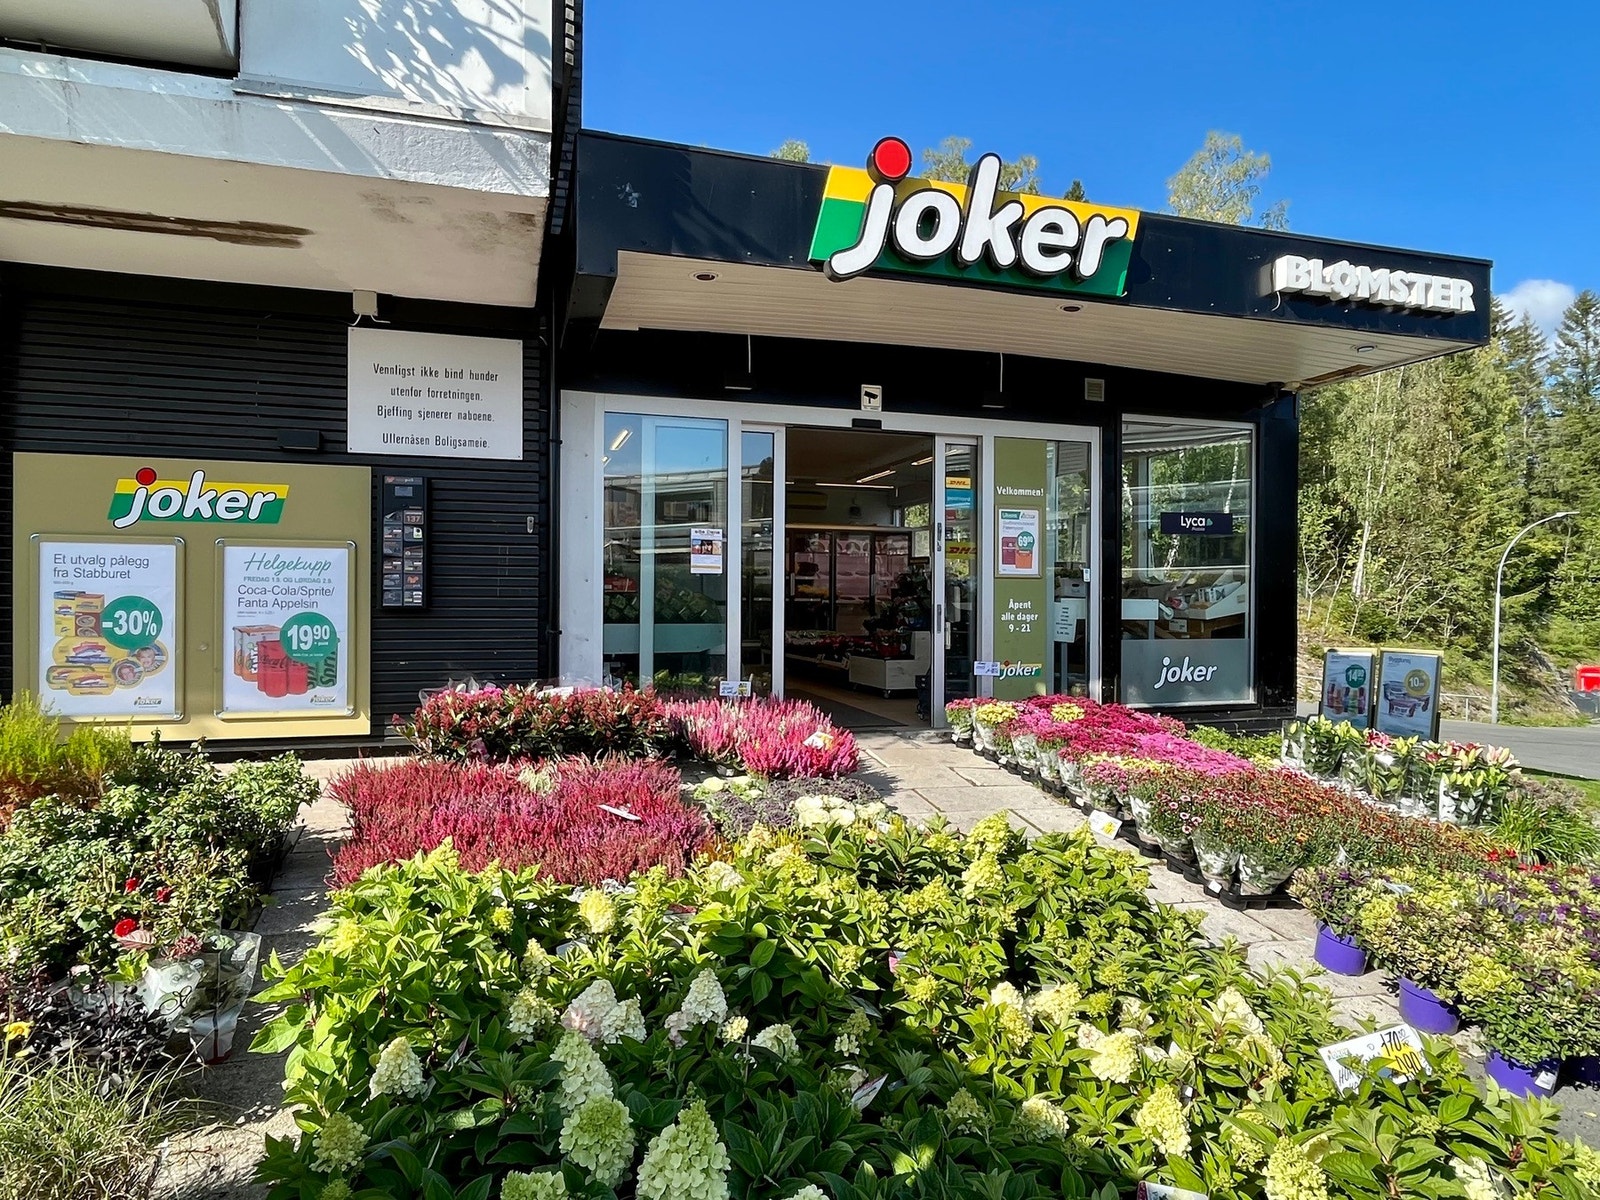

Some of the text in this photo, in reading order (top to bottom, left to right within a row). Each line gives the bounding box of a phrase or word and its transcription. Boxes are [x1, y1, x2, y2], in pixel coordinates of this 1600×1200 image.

[823, 136, 1128, 283] joker
[1275, 254, 1476, 315] BLOMSTER
[373, 363, 499, 382] Vennligst ikke bind hunder
[390, 386, 483, 403] utenfor forretningen.
[377, 405, 495, 422] Bjeffing sjenerer naboene.
[382, 432, 490, 450] Ullernåsen Boligsameie.
[113, 467, 277, 529] joker
[996, 486, 1044, 497] Velkommen!
[1180, 515, 1206, 528] Lyca
[53, 553, 150, 569] Et utvalg pålegg
[243, 552, 332, 577] Helgekupp
[53, 567, 131, 579] fra Stabburet
[237, 584, 335, 598] Coca-Cola/Sprite/
[237, 597, 319, 610] Fanta Appelsin
[1008, 598, 1032, 610] Åpent
[102, 610, 157, 636] -30%
[1001, 612, 1039, 622] alle dager
[1008, 623, 1015, 633] 9
[1021, 623, 1031, 633] 21
[1000, 660, 1040, 681] joker
[1154, 656, 1218, 689] joker
